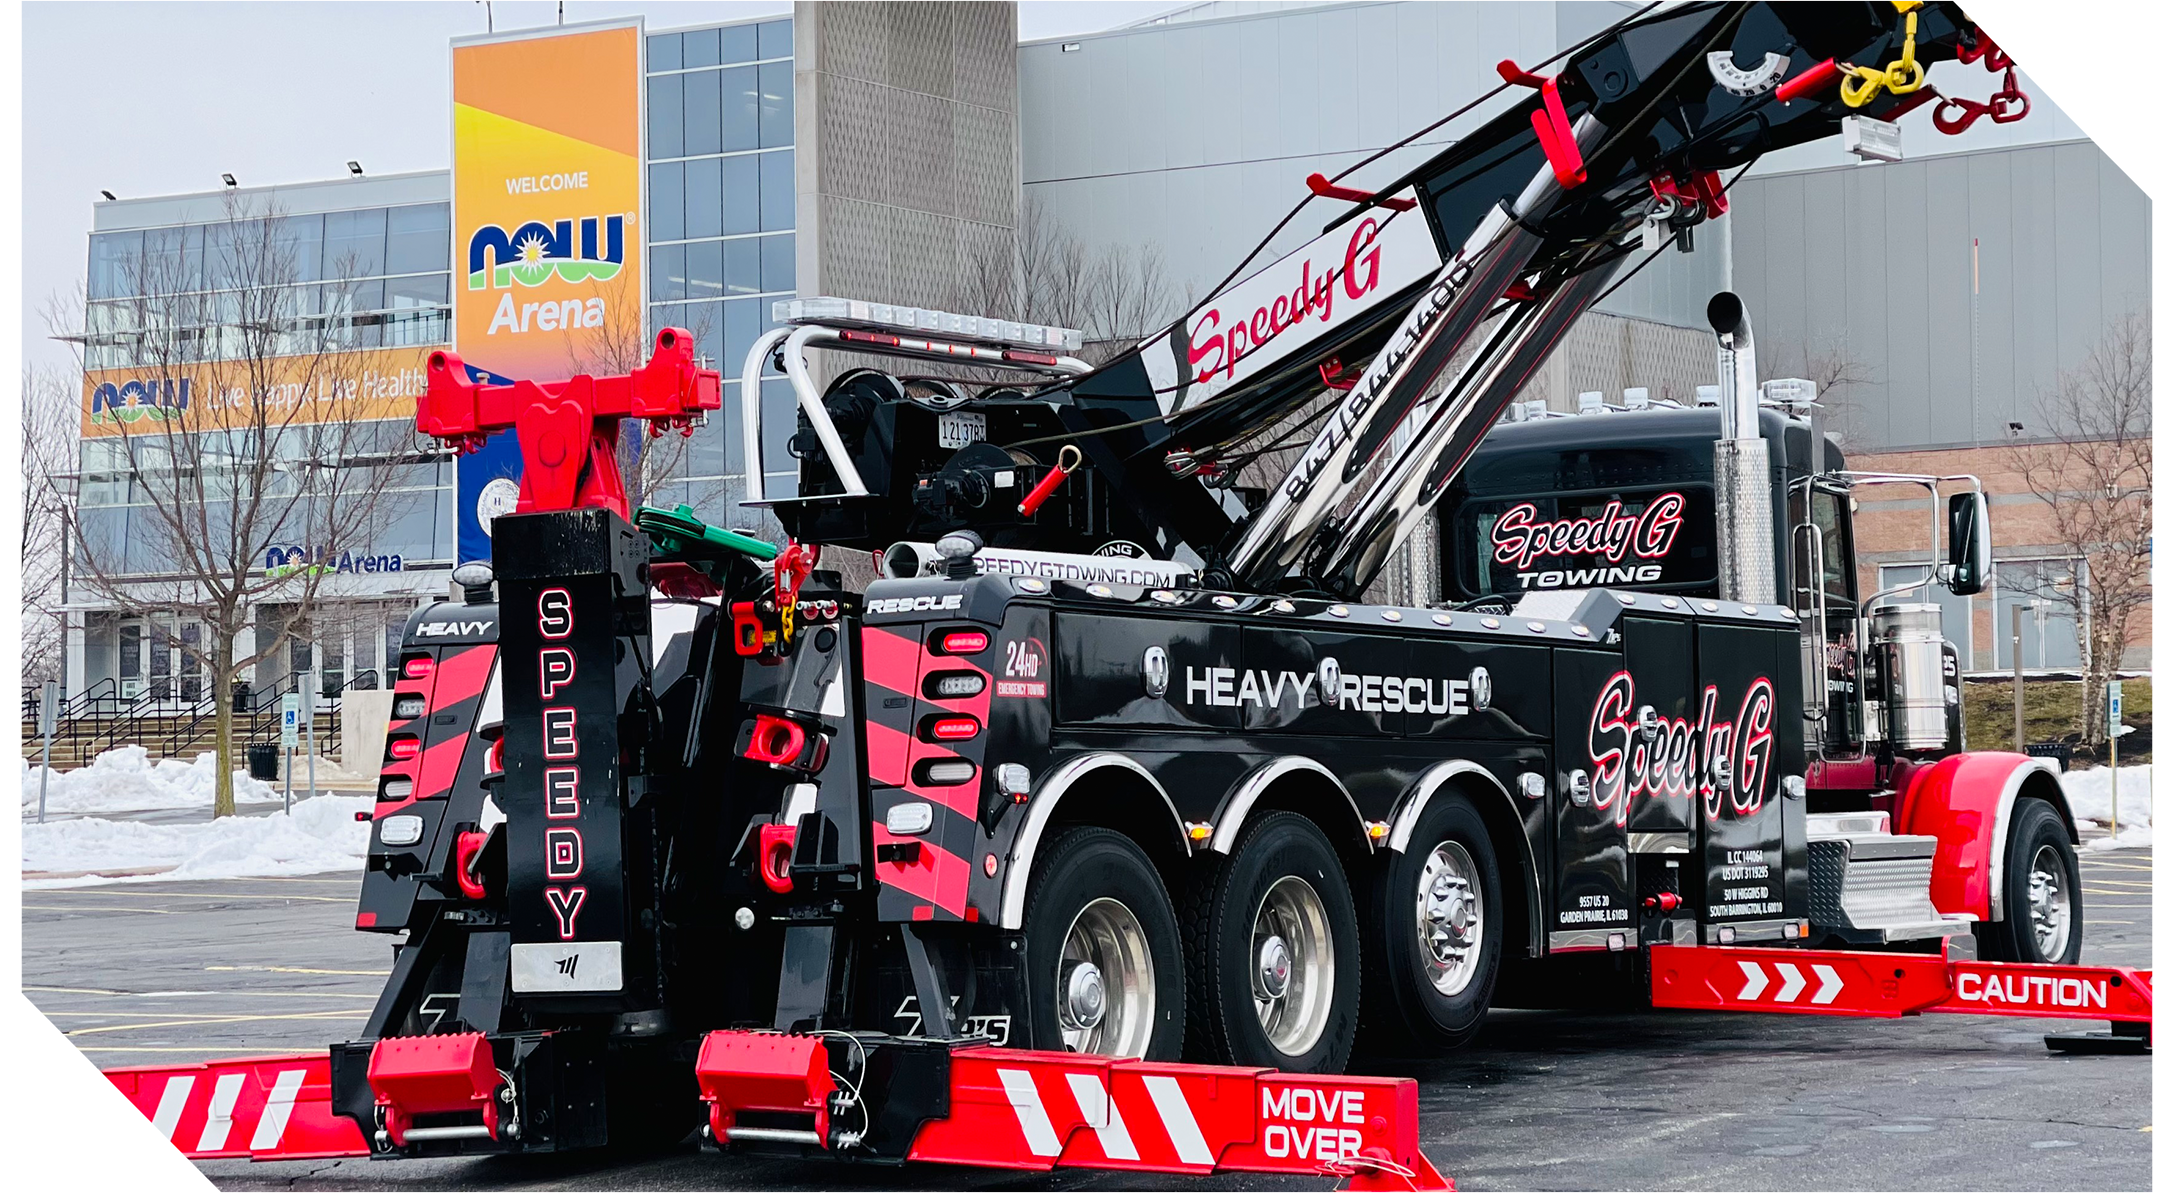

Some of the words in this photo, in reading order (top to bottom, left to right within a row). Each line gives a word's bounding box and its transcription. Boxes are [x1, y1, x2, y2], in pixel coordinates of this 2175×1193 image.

[506, 172, 589, 195] WELCOME
[487, 292, 605, 335] Arena
[1188, 259, 1334, 384] Speedy
[1343, 217, 1382, 300] G
[1285, 259, 1474, 502] 847/844-1400
[207, 381, 244, 410] Live
[1490, 500, 1639, 570] Speedy
[1633, 491, 1685, 559] G
[337, 549, 403, 574] Arena
[973, 557, 1172, 589] PEEDYGTOWING.COM
[1517, 565, 1662, 589] TOWING
[867, 594, 963, 615] RESCUE
[416, 621, 493, 637] HEAVY
[998, 682, 1026, 695] EMERGENCY
[1027, 683, 1044, 696] TOWING
[1186, 666, 1316, 709] HEAVY
[1339, 675, 1469, 715] RESCUE
[1589, 670, 1732, 828] Speedy
[1731, 676, 1775, 815] G
[538, 587, 588, 940] SPEEDY
[1734, 851, 1742, 863] CC
[1722, 867, 1731, 881] US
[1732, 866, 1744, 880] DOT
[1593, 895, 1601, 907] US
[1602, 895, 1610, 907] 20
[1732, 888, 1738, 900] W
[1738, 887, 1760, 900] HIGGINS
[1760, 886, 1769, 899] RD
[1560, 910, 1584, 924] GARDEN
[1584, 909, 1606, 923] PRAIRIE,
[1710, 904, 1728, 918] SOUTH
[1728, 902, 1762, 916] BARRINGTON,
[1958, 973, 2107, 1009] CAUTION
[1263, 1087, 1365, 1124] MOVE
[1265, 1125, 1362, 1165] OVER
